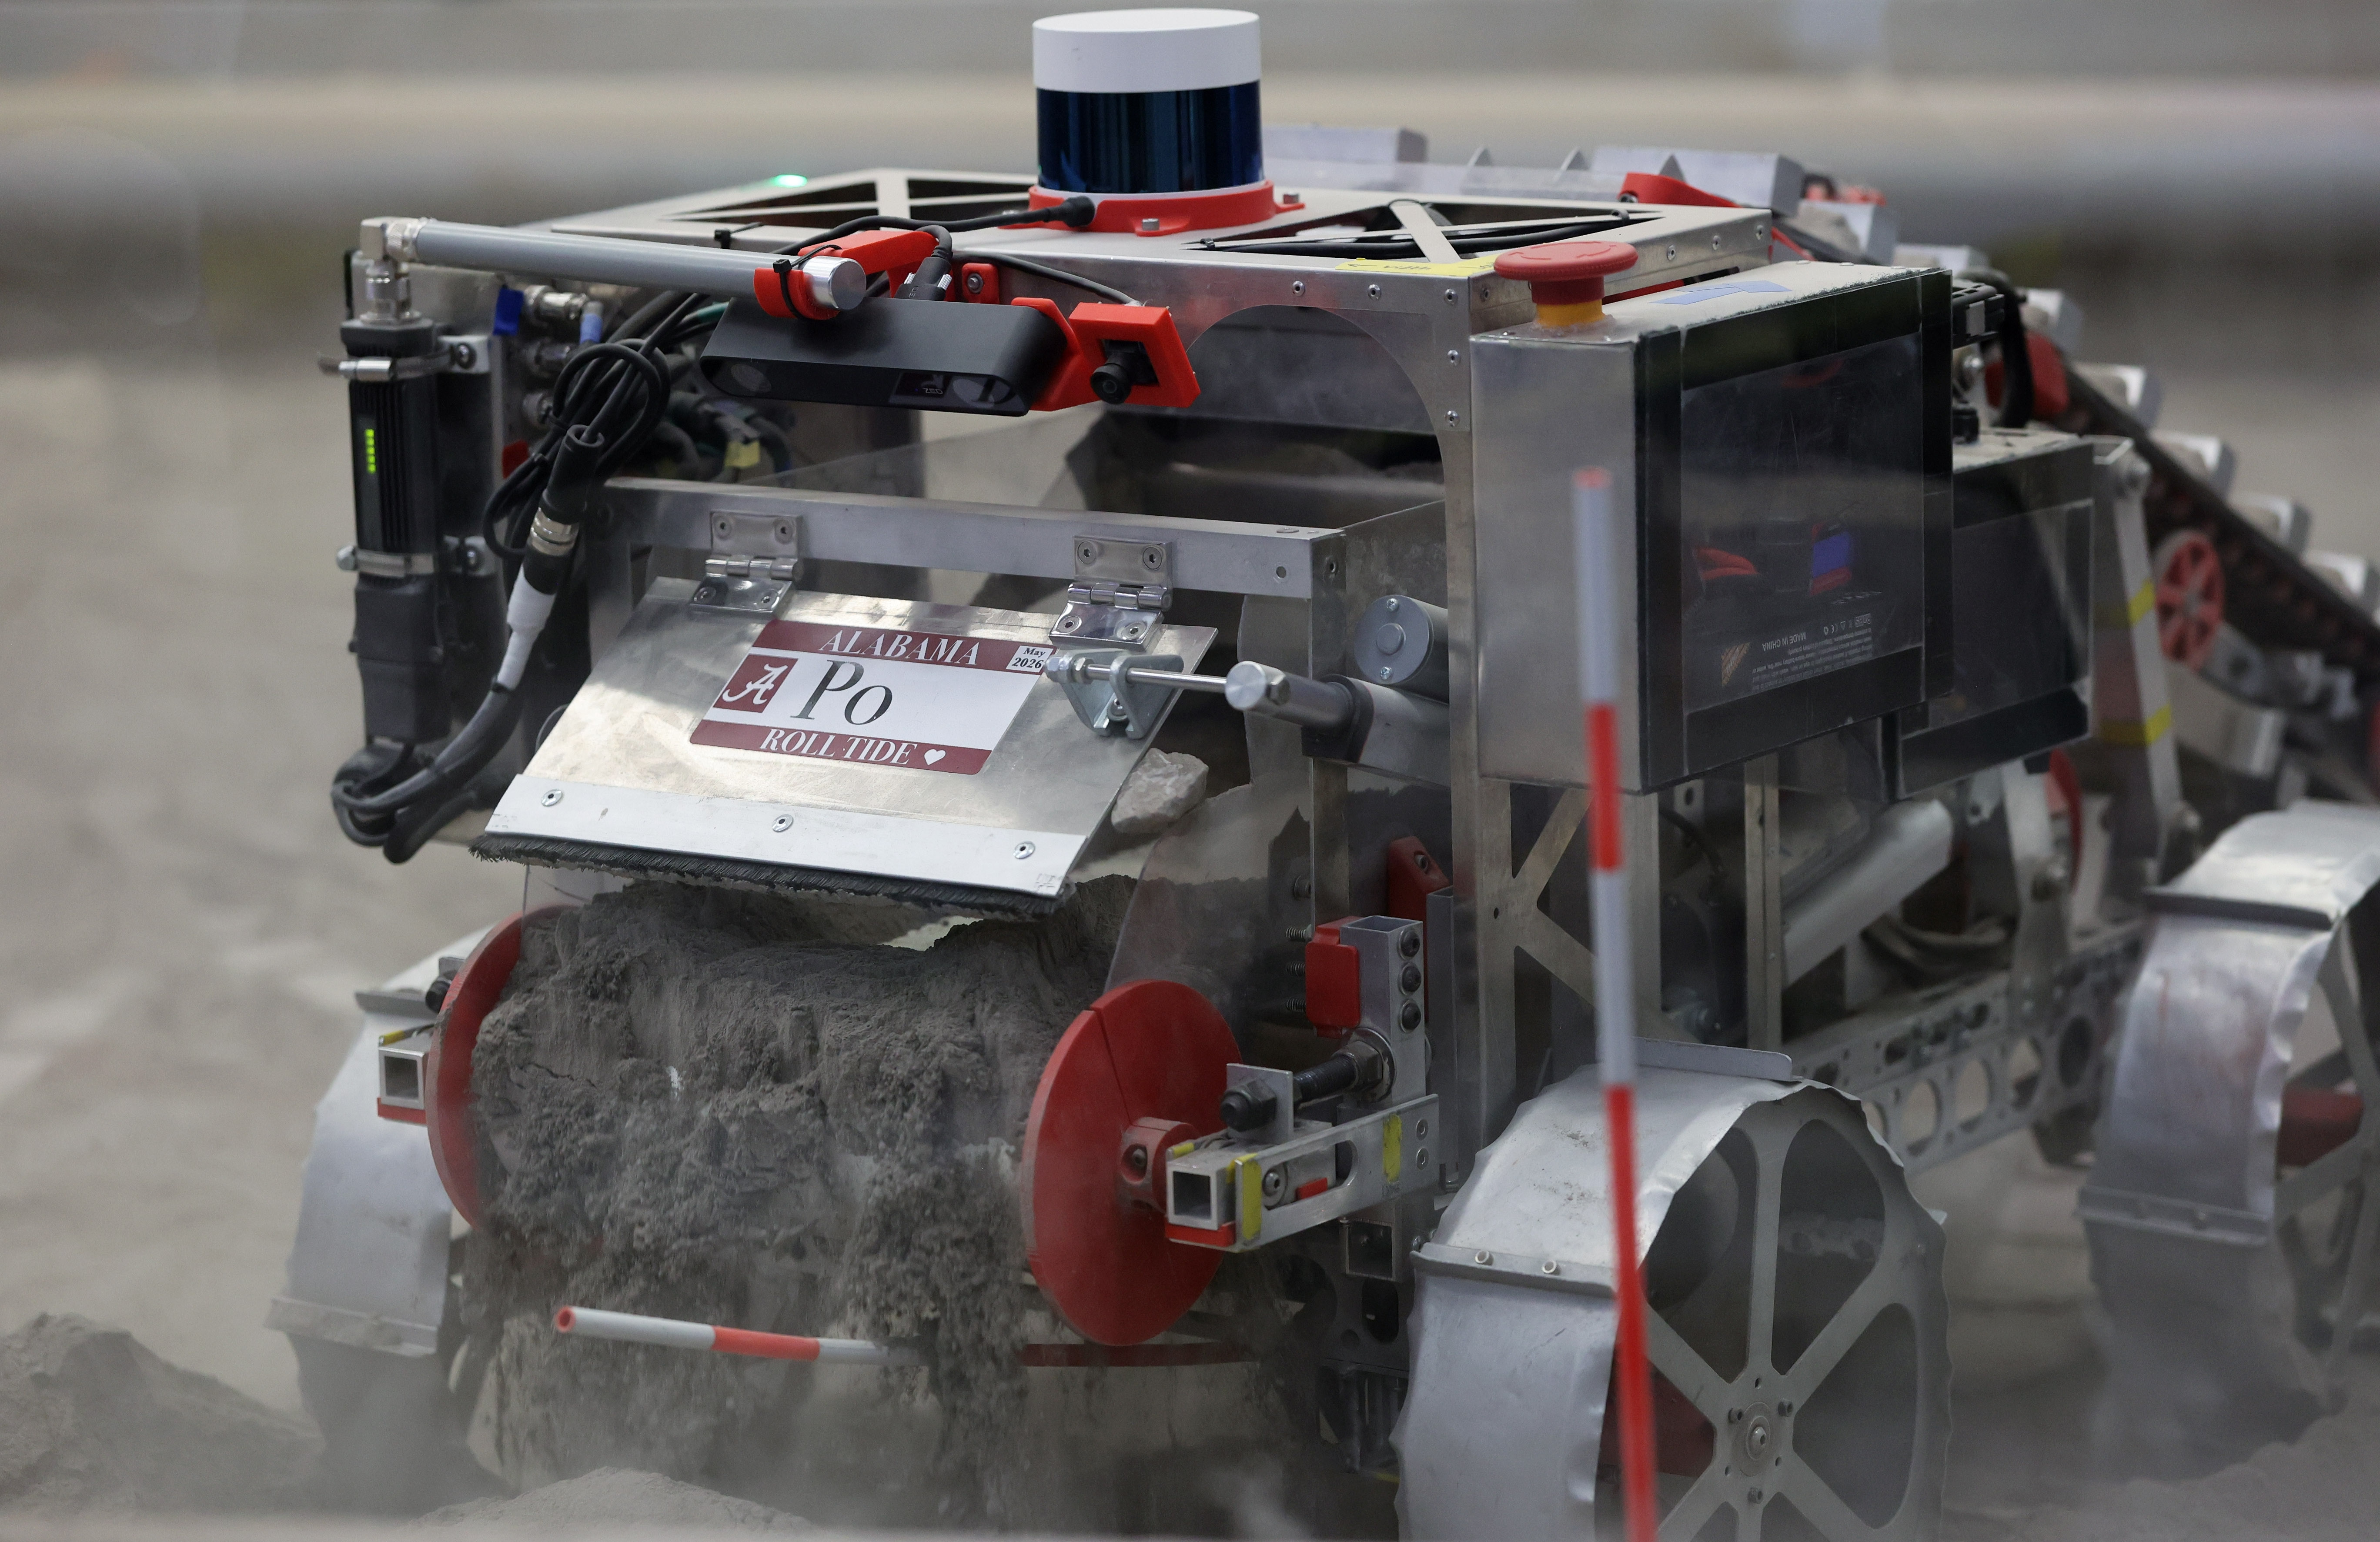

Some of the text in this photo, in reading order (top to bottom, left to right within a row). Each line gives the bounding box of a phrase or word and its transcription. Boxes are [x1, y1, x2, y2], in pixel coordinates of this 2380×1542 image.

[909, 286, 919, 298] ED
[818, 630, 979, 665] ALABAMA
[1023, 648, 1046, 658] May
[1762, 632, 1806, 651] MADE IN CHINA
[1012, 658, 1044, 668] 2026
[722, 664, 788, 705] A
[789, 659, 892, 725] Po
[759, 728, 918, 764] ROLL TIDE
